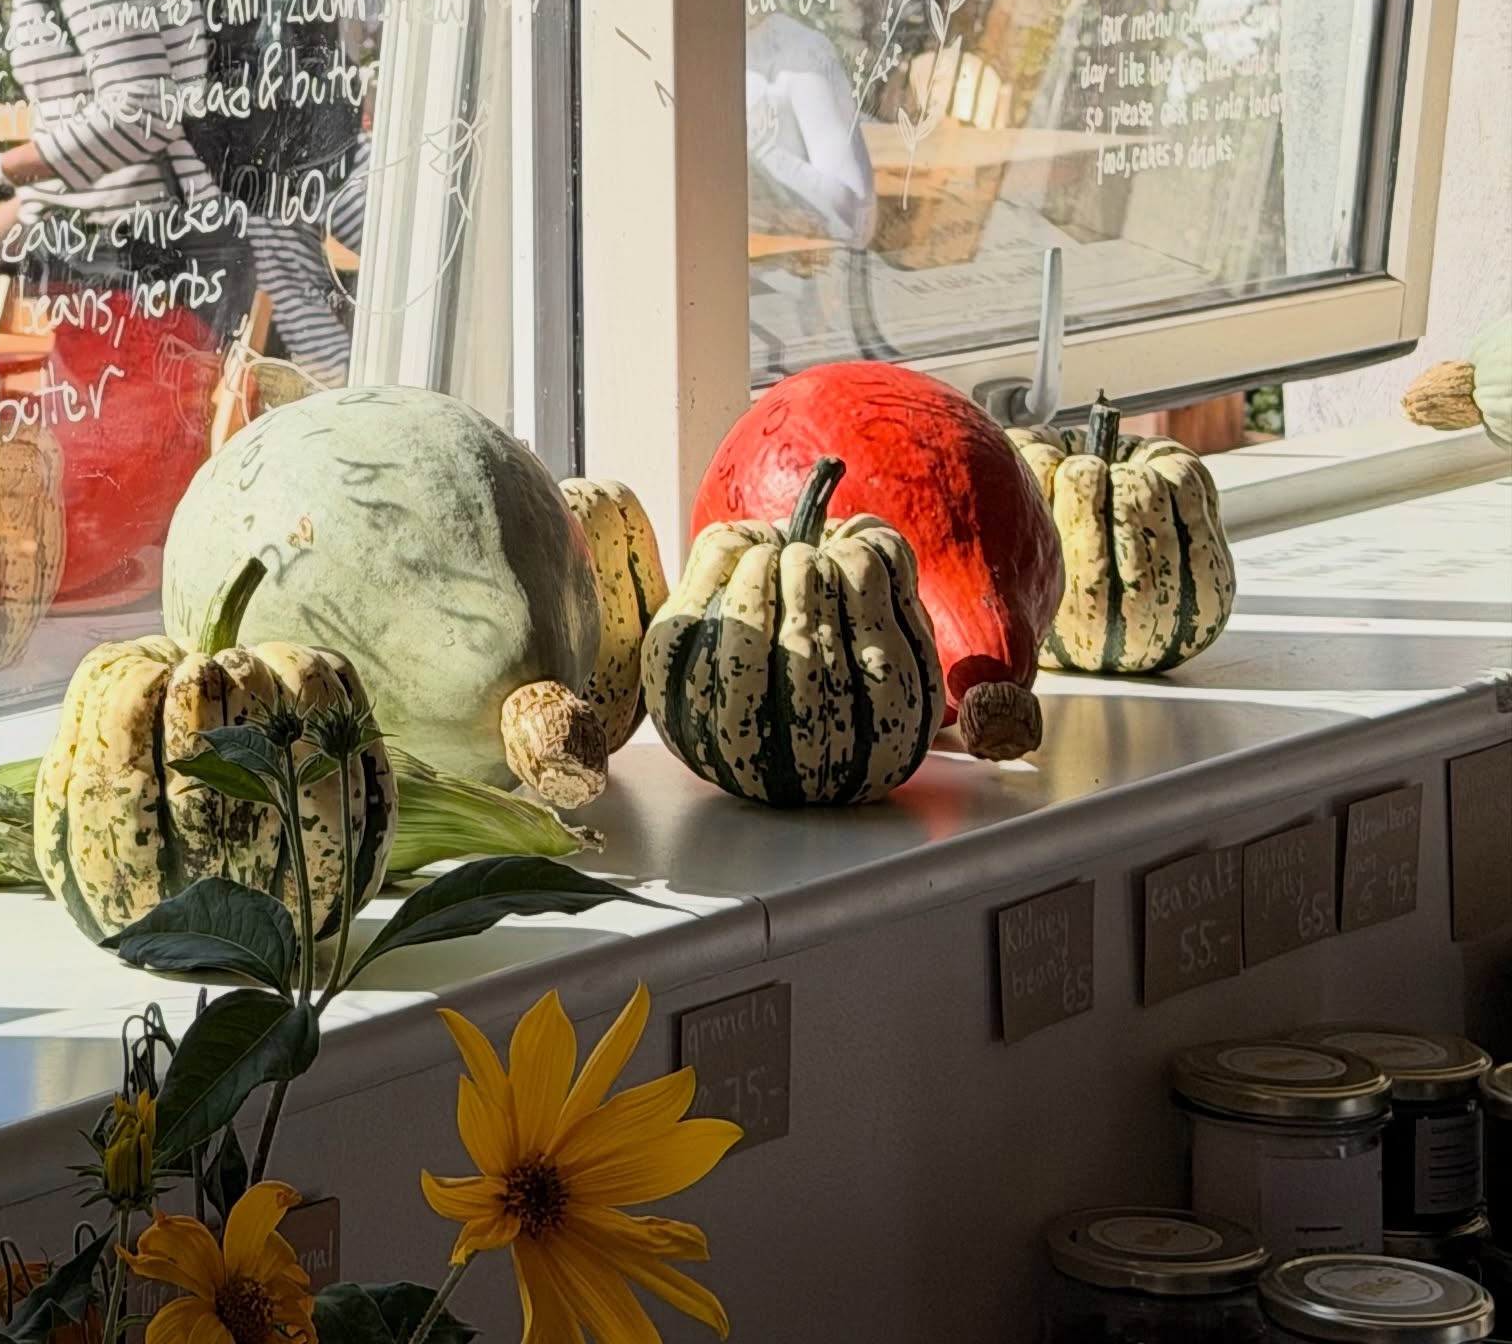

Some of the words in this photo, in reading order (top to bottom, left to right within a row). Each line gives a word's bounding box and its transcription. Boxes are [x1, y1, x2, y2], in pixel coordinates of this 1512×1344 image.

[158, 62, 252, 134] bread
[257, 40, 285, 111] &
[290, 47, 384, 110] butter
[110, 185, 250, 249] chicken
[131, 265, 228, 322] herbs
[1186, 851, 1239, 911] salt
